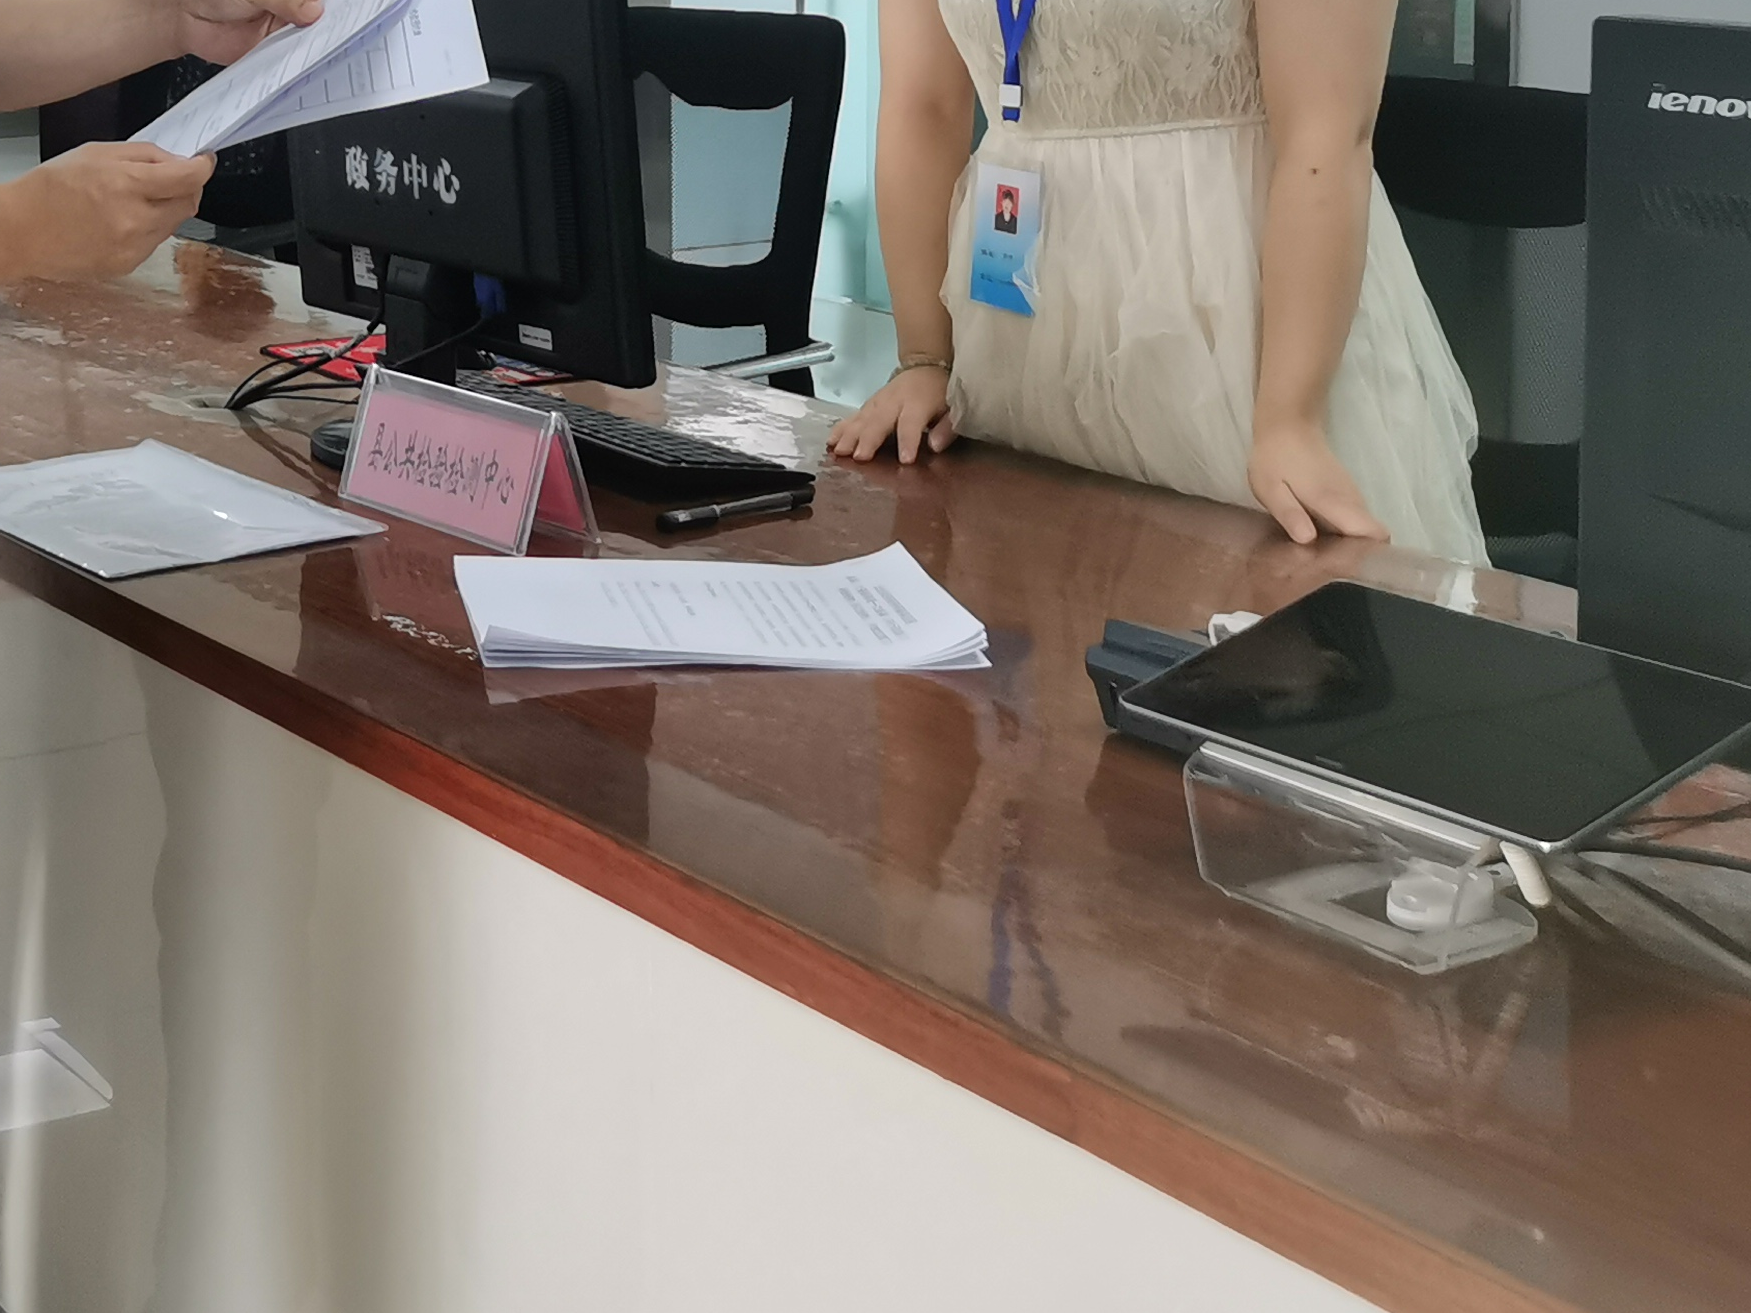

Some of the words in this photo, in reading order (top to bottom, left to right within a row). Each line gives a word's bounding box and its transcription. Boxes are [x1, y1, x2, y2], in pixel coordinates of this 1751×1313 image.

[1647, 82, 1751, 119] leno
[344, 145, 461, 204] 政务中心
